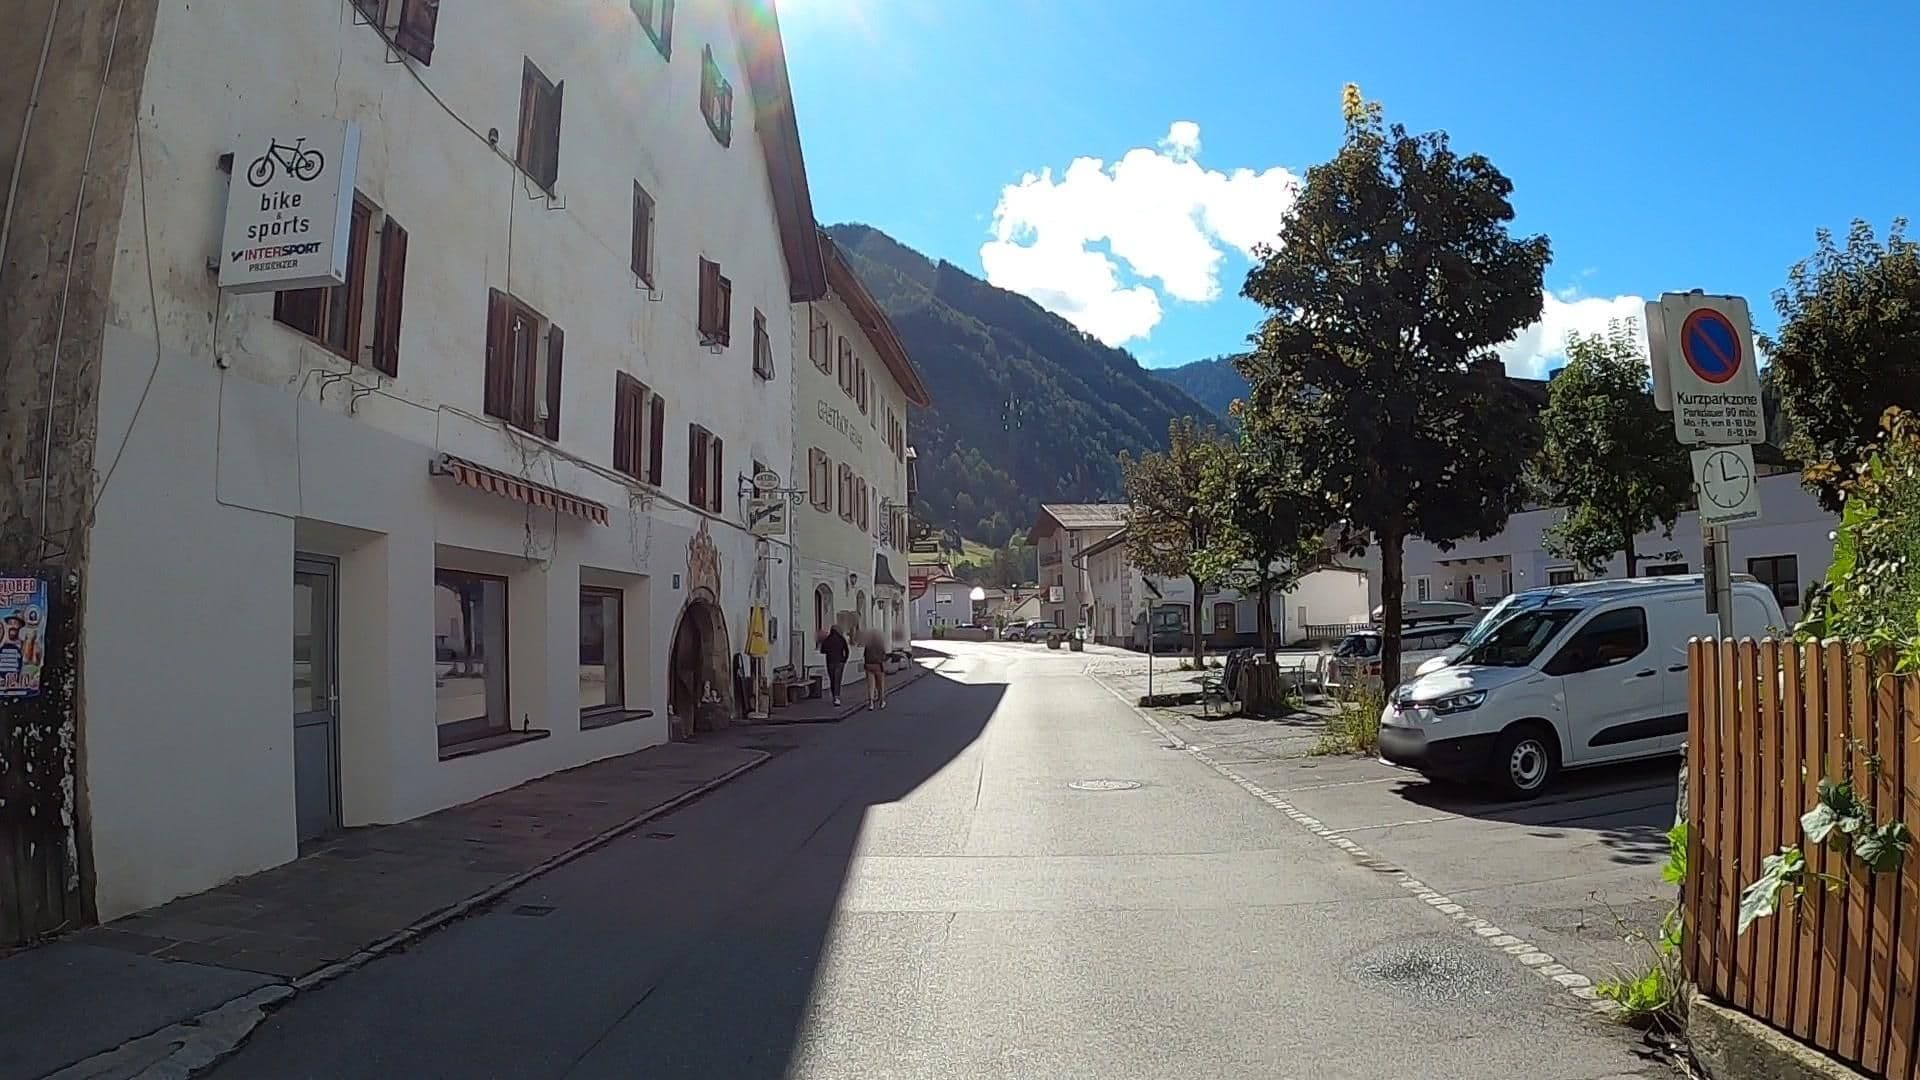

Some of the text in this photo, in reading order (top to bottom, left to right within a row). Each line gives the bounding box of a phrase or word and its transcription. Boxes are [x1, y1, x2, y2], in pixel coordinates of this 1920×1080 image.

[261, 191, 302, 211] bike
[248, 216, 310, 242] sports
[245, 242, 321, 260] INTERSPORT
[1677, 391, 1758, 409] Kurzparkzone
